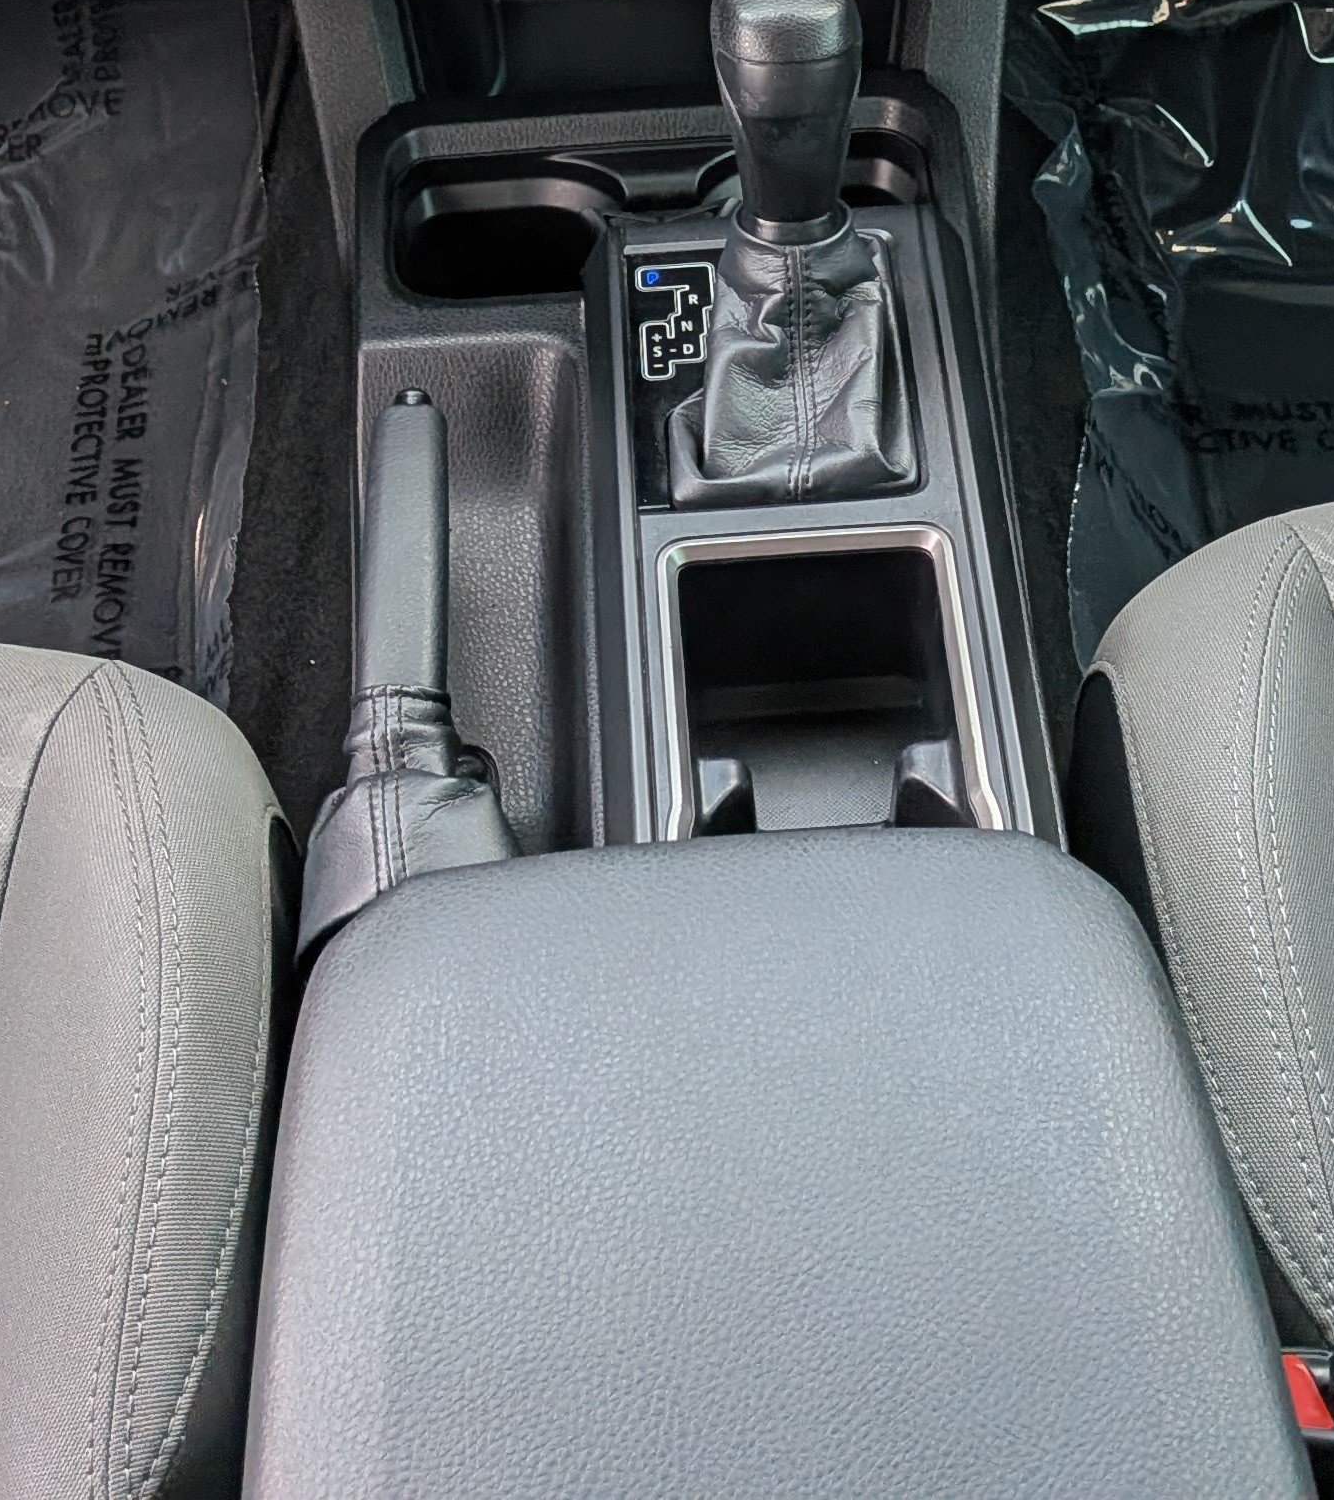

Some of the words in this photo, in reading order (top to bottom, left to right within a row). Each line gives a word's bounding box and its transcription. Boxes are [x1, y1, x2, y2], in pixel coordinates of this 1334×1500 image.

[688, 293, 699, 305] R
[680, 320, 693, 332] N
[652, 345, 663, 358] S
[682, 343, 694, 355] D
[116, 344, 150, 442] DEALER
[65, 353, 113, 506] PROTECTIVE
[105, 458, 143, 530] MUST
[49, 514, 94, 602] COVER
